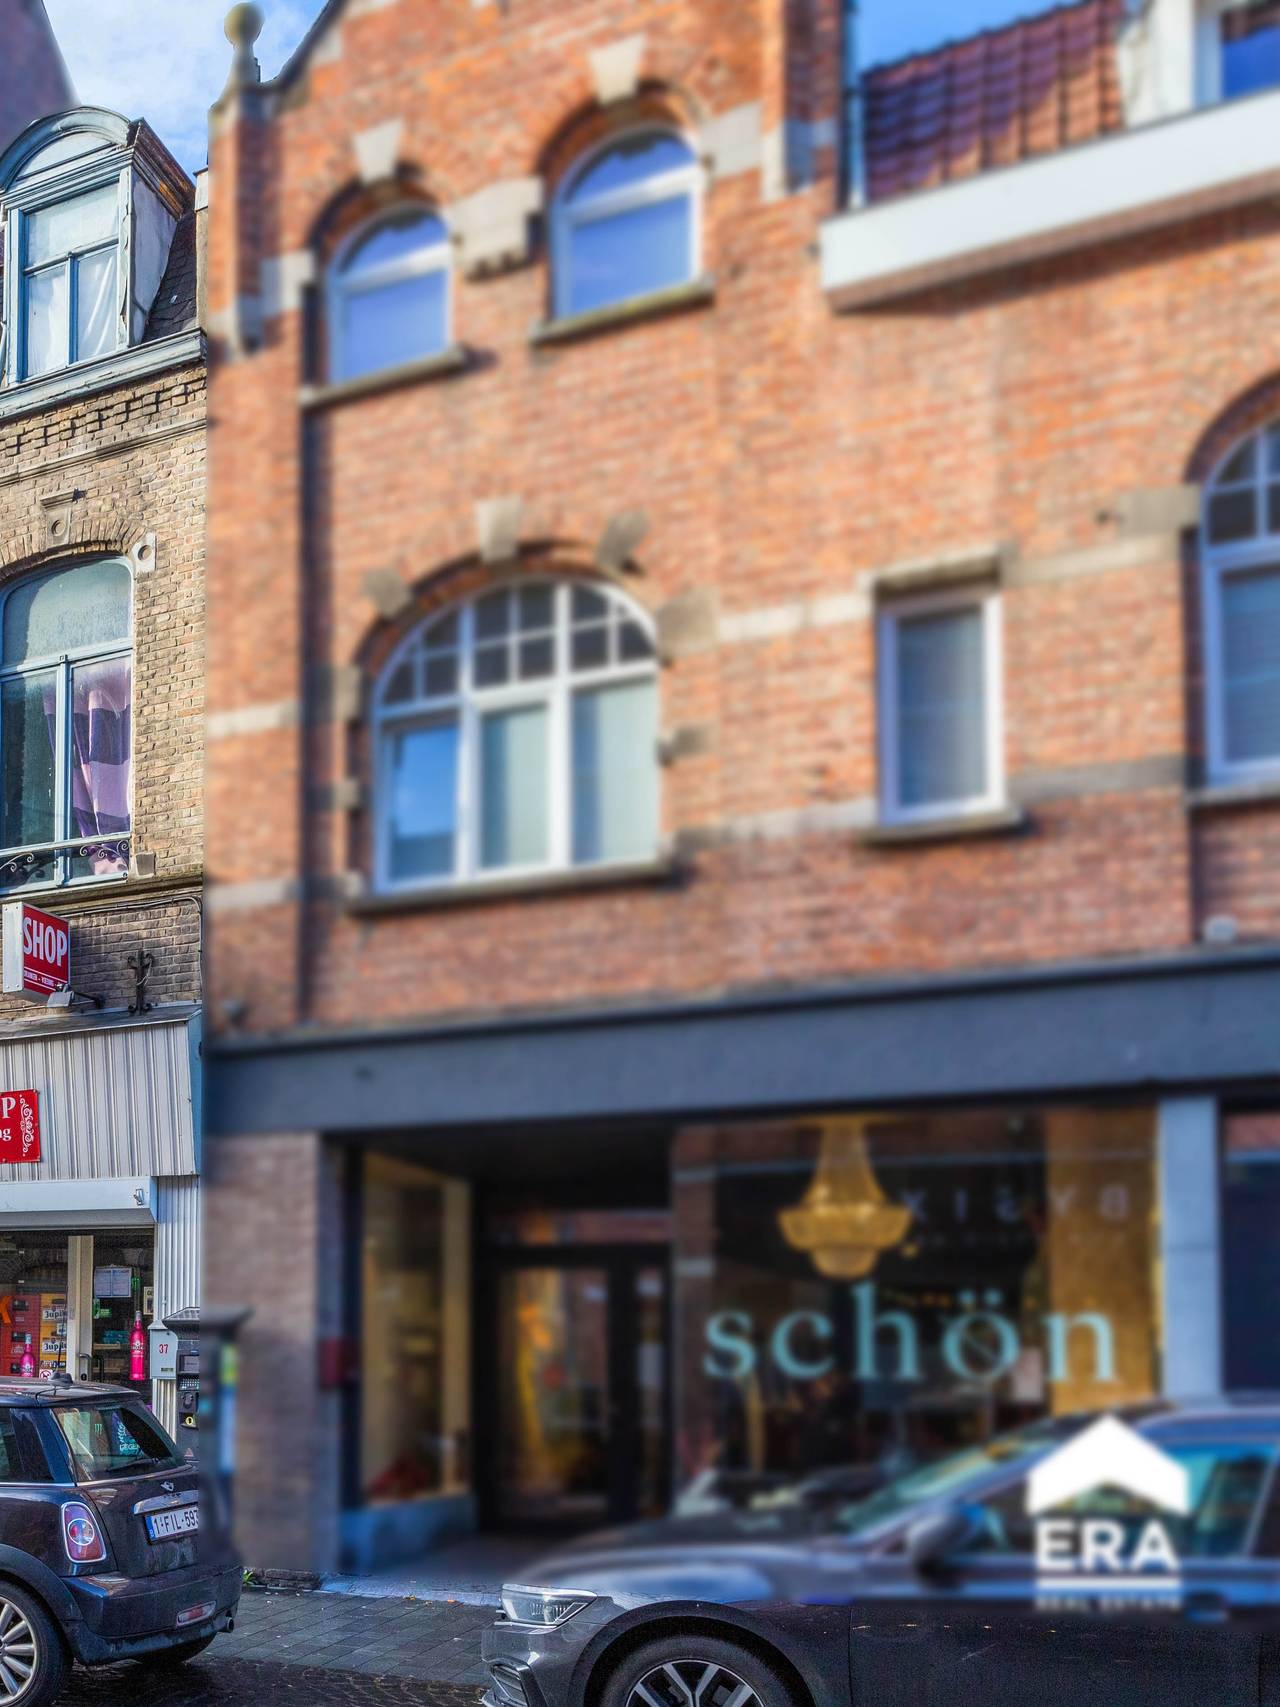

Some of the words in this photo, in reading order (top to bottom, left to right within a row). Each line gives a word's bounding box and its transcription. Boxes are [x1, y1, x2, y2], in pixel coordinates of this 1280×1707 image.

[23, 917, 68, 967] SHOP
[159, 1343, 169, 1354] 37
[702, 1281, 1118, 1382] schön
